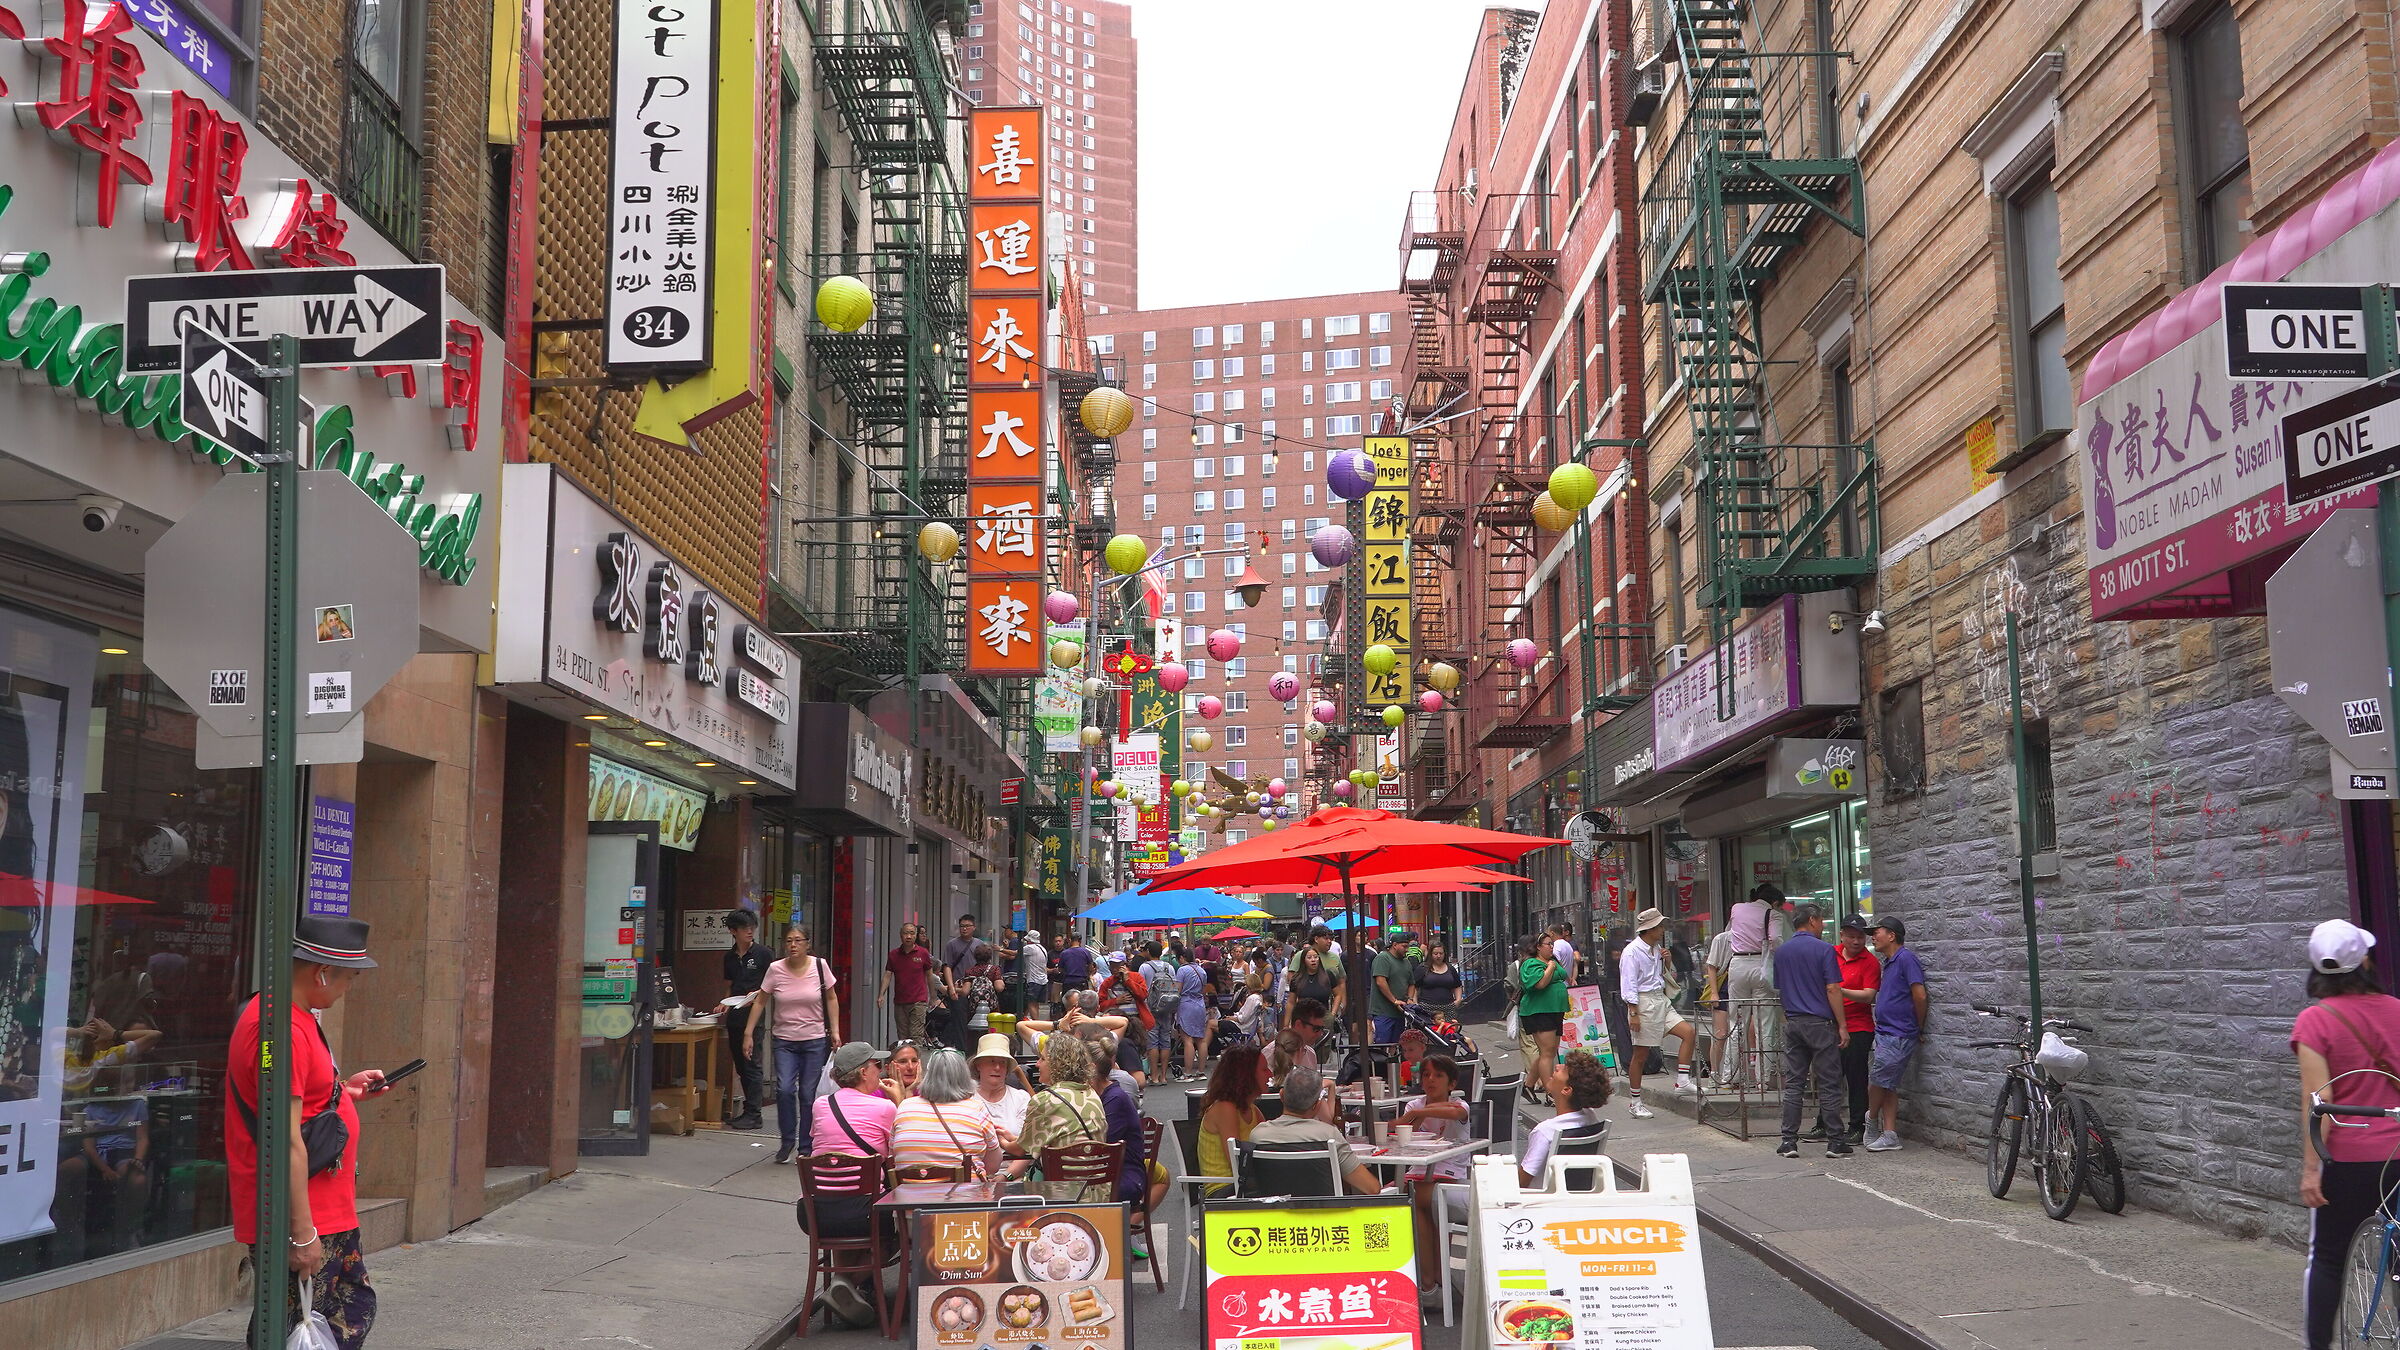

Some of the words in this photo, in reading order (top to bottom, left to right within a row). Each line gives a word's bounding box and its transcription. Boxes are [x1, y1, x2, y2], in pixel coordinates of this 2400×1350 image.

[616, 185, 651, 293] 四川小炒
[173, 301, 260, 338] ONE
[303, 298, 395, 335] WAY
[633, 312, 675, 340] 34
[2271, 314, 2357, 349] ONE
[208, 368, 249, 426] ONE
[975, 124, 1038, 658] 喜運來大酒家
[2114, 371, 2222, 485] 貴夫人
[1373, 442, 1402, 458] Joe's
[2313, 415, 2373, 468] ONE
[2235, 437, 2272, 479] Susan
[1376, 461, 1408, 481] inger
[2295, 491, 2310, 500] DEPT
[2326, 471, 2375, 491] TRANSPORTATION
[2119, 503, 2160, 541] NOBLE
[2168, 473, 2223, 520] MADAM
[2100, 572, 2116, 601] 38
[2119, 549, 2161, 593] MOTT
[2164, 539, 2190, 574] ST.
[1367, 494, 1409, 699] 錦江飯店
[556, 644, 568, 672] 34
[571, 651, 594, 685] PELL
[211, 672, 247, 686] EXOE
[210, 686, 246, 704] REMAND
[2343, 700, 2379, 717] EXOE
[2346, 713, 2383, 736] REMAND
[1379, 737, 1396, 746] Bar
[1114, 752, 1157, 766] PELL
[327, 808, 350, 825] DENTAL
[322, 862, 343, 878] HOURS
[1044, 835, 1061, 895] 佛有緣
[942, 1221, 982, 1240] 广式
[1268, 1225, 1350, 1247] 熊猫外卖
[1557, 1226, 1668, 1246] LUNCH
[942, 1243, 982, 1261] 点心
[1268, 1246, 1350, 1254] HUNGRYPANDA
[940, 1270, 962, 1281] Dim
[1582, 1264, 1629, 1273] MON-FRI
[1632, 1264, 1654, 1272] 11-4
[1258, 1284, 1374, 1324] 水煮鱼
